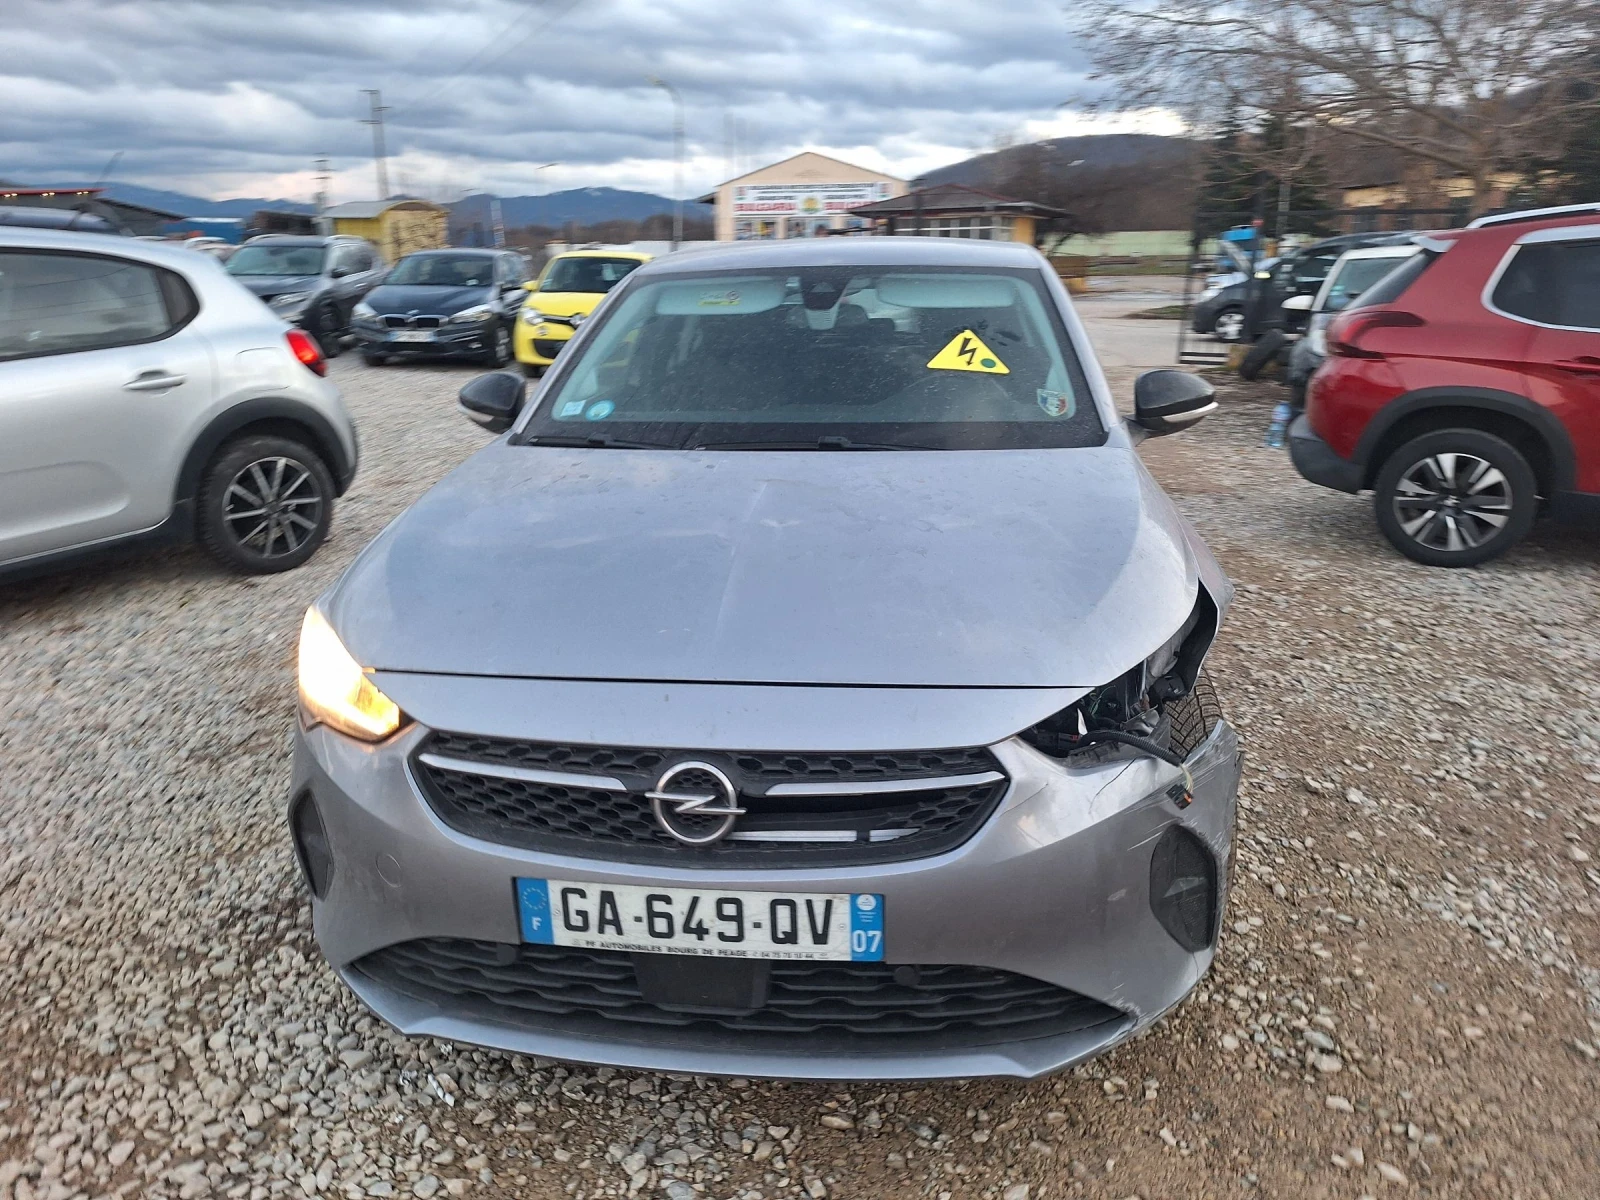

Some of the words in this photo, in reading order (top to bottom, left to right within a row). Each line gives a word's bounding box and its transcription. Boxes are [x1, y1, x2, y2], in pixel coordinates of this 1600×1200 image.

[531, 916, 542, 930] F
[560, 887, 832, 945] GA-649-QV
[852, 929, 882, 953] 07
